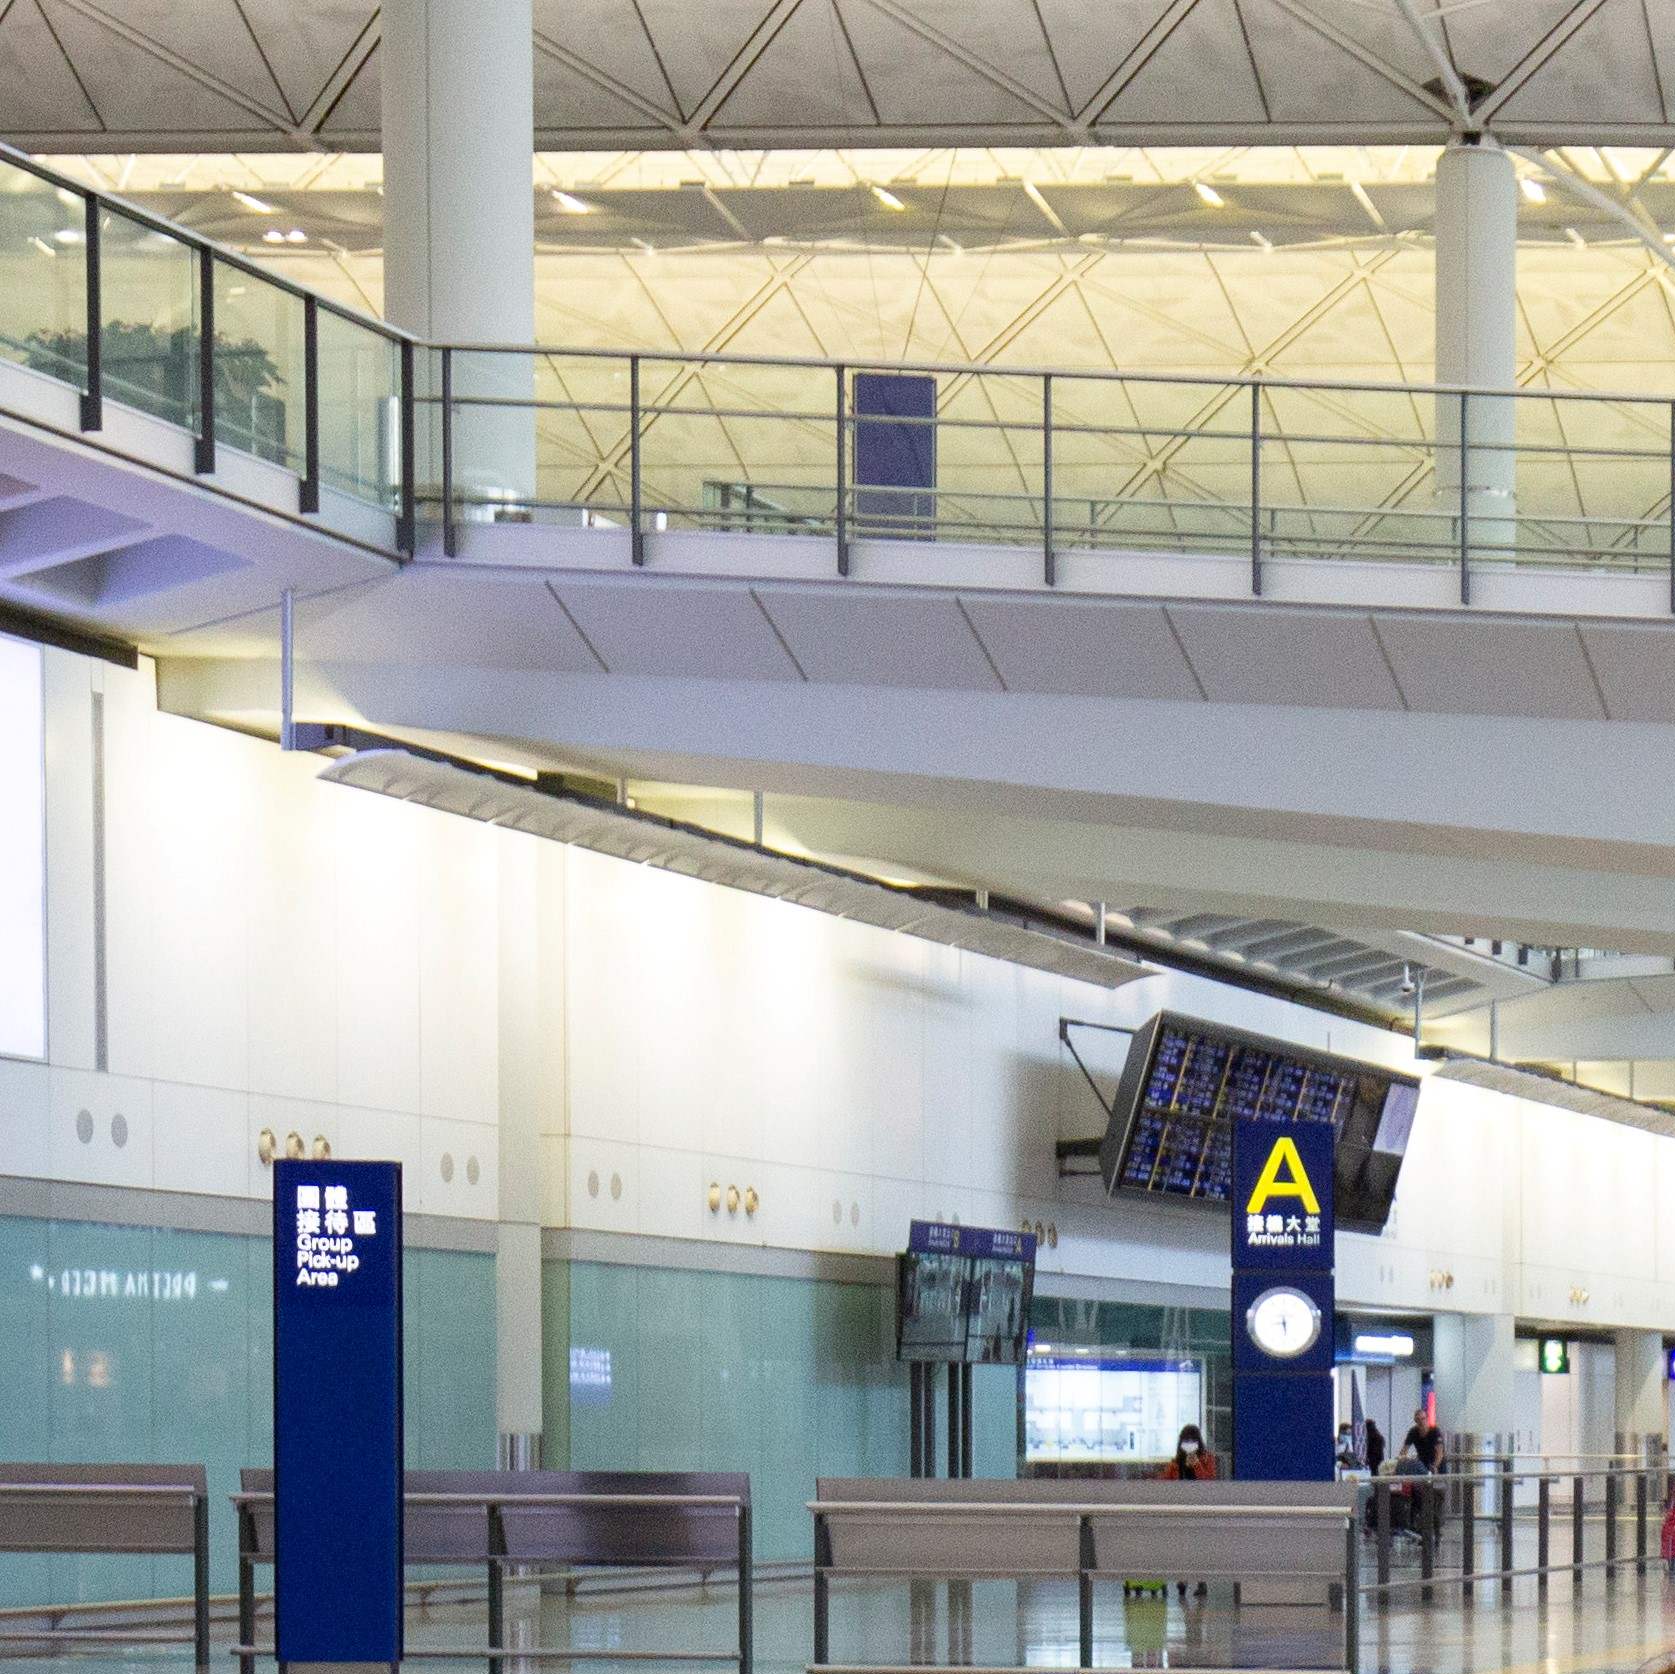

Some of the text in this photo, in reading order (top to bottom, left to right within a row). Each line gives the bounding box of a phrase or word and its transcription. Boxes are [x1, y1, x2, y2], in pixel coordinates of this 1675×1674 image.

[1246, 1136, 1321, 1215] A
[297, 1233, 353, 1254] Group
[1247, 1231, 1320, 1246] Arrivals Hall
[297, 1250, 360, 1272] Pick-up
[297, 1267, 339, 1286] Area
